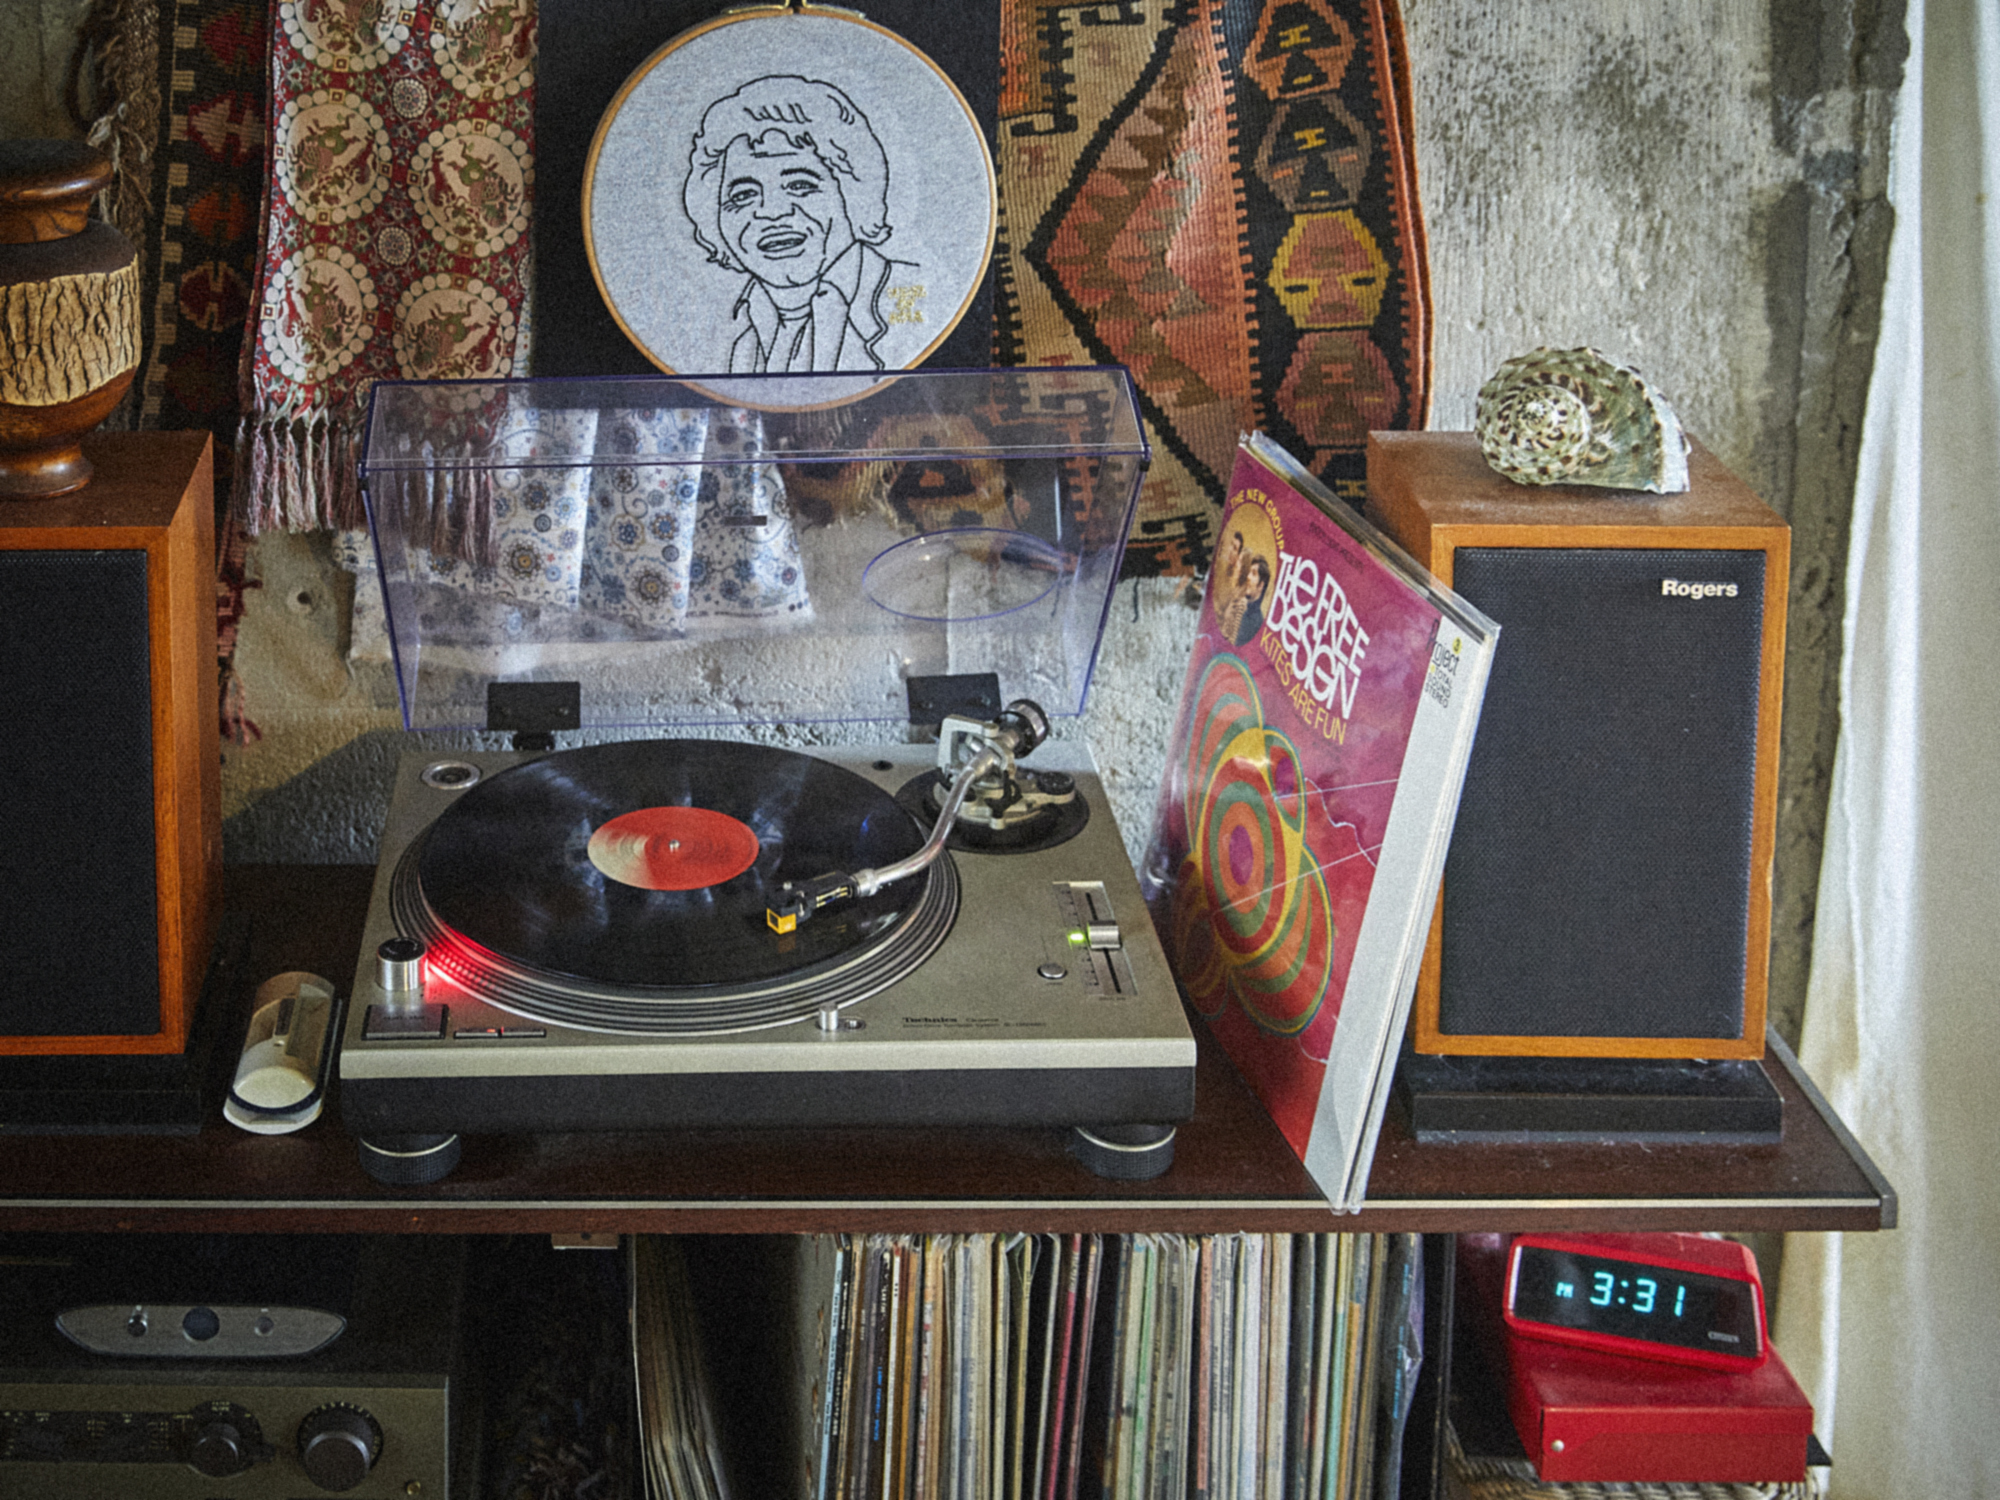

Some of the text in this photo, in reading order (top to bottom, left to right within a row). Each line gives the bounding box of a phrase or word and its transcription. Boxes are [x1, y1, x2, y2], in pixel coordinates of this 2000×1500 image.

[1230, 488, 1285, 550] THE NEW GROUP
[1661, 579, 1739, 600] Rogers
[1315, 572, 1370, 677] FREE
[1425, 618, 1460, 676] Project
[1260, 627, 1294, 686] KITES
[1435, 667, 1453, 689] TOTAL
[1425, 682, 1449, 708] STEREO
[1428, 672, 1451, 699] SOUND
[1288, 683, 1316, 725] ARE
[1314, 706, 1347, 745] FUN
[1590, 1271, 1686, 1317] 3:31
